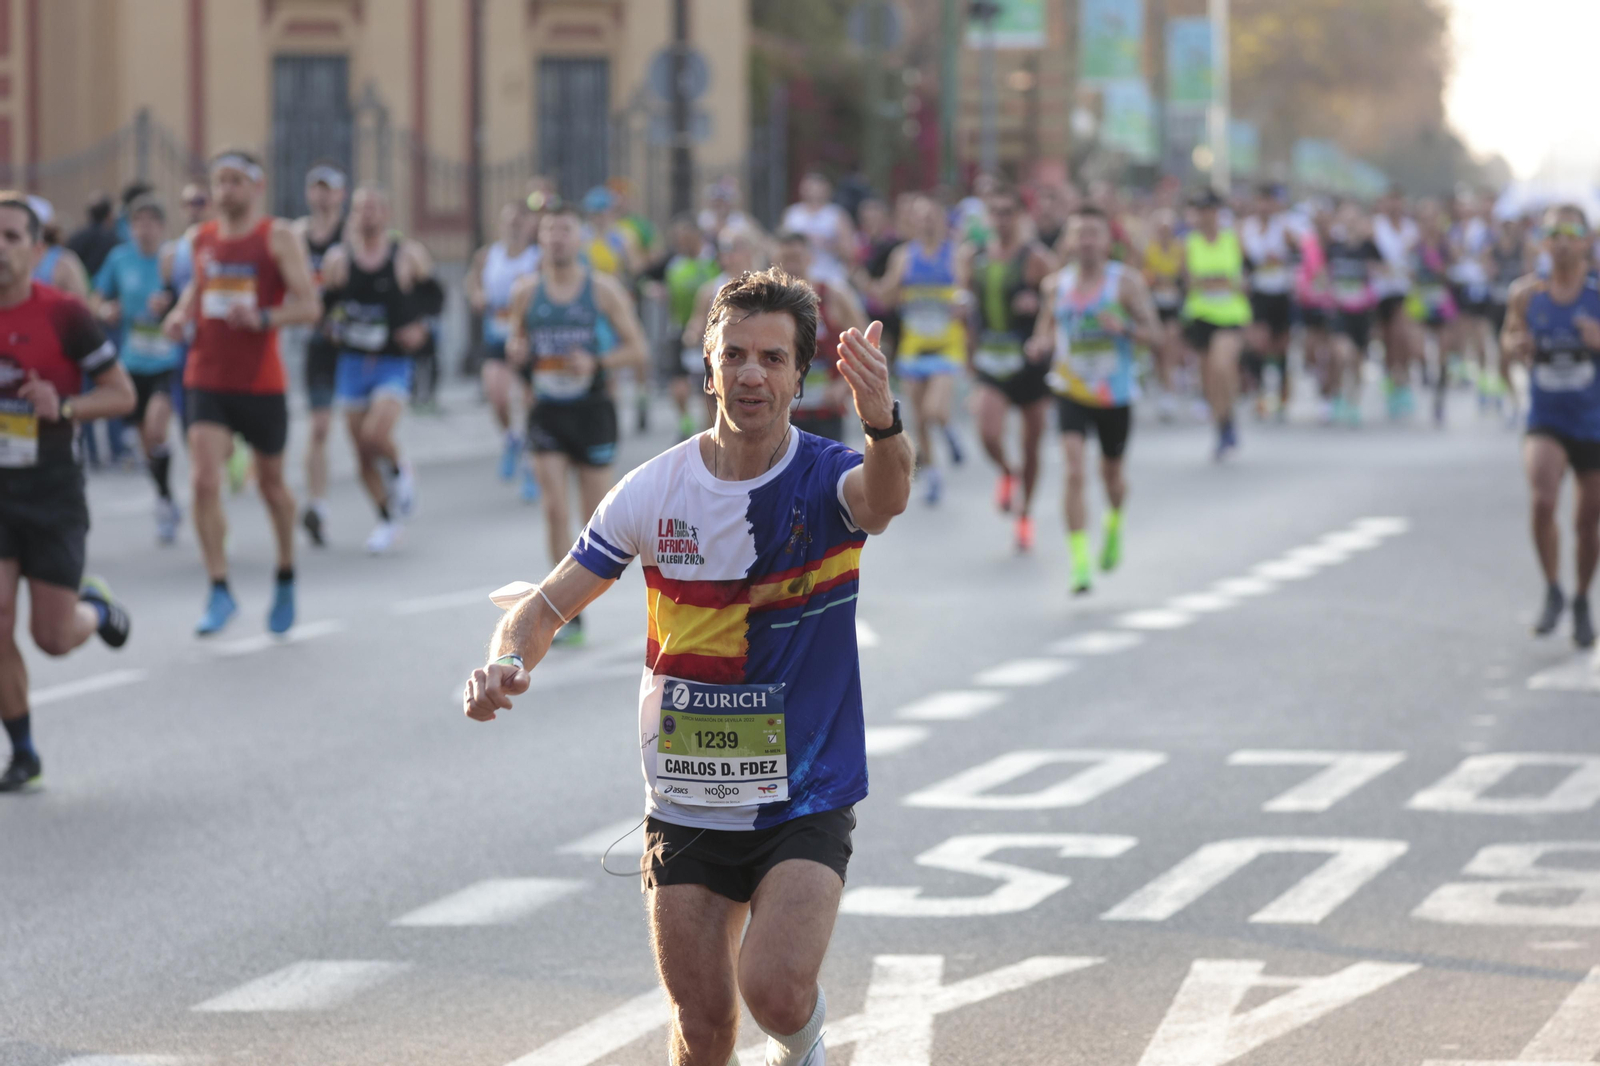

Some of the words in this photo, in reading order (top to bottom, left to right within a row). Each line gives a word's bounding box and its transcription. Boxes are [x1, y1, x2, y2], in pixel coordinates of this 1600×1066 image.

[658, 518, 674, 538] LA
[656, 554, 666, 564] LA
[693, 692, 767, 708] ZURICH
[695, 730, 739, 749] 1239
[665, 759, 716, 776] CARLOS
[721, 763, 735, 776] D.
[740, 760, 778, 776] FDEZ
